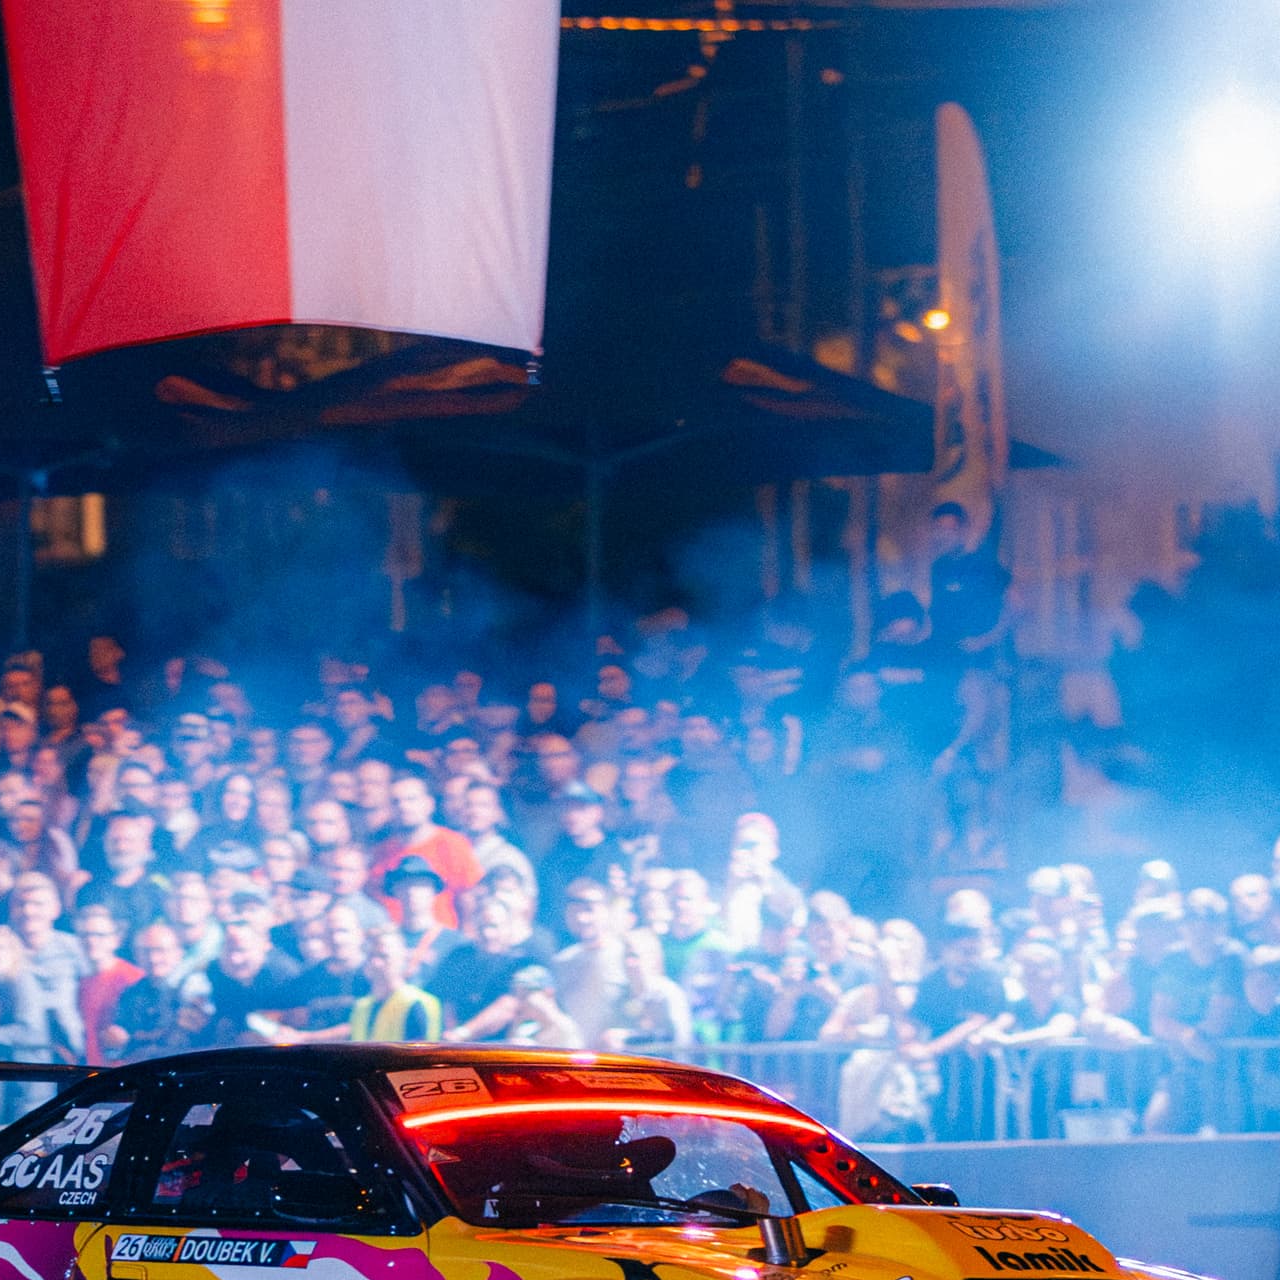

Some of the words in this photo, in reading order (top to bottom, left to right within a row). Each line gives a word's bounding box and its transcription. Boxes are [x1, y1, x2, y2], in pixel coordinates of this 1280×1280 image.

[400, 1079, 480, 1099] 26
[51, 1107, 112, 1145] 26
[36, 1154, 108, 1190] AAS
[58, 1191, 97, 1205] CZECH
[119, 1236, 142, 1259] 26
[180, 1239, 259, 1263] DOUBEK
[259, 1243, 276, 1264] V.
